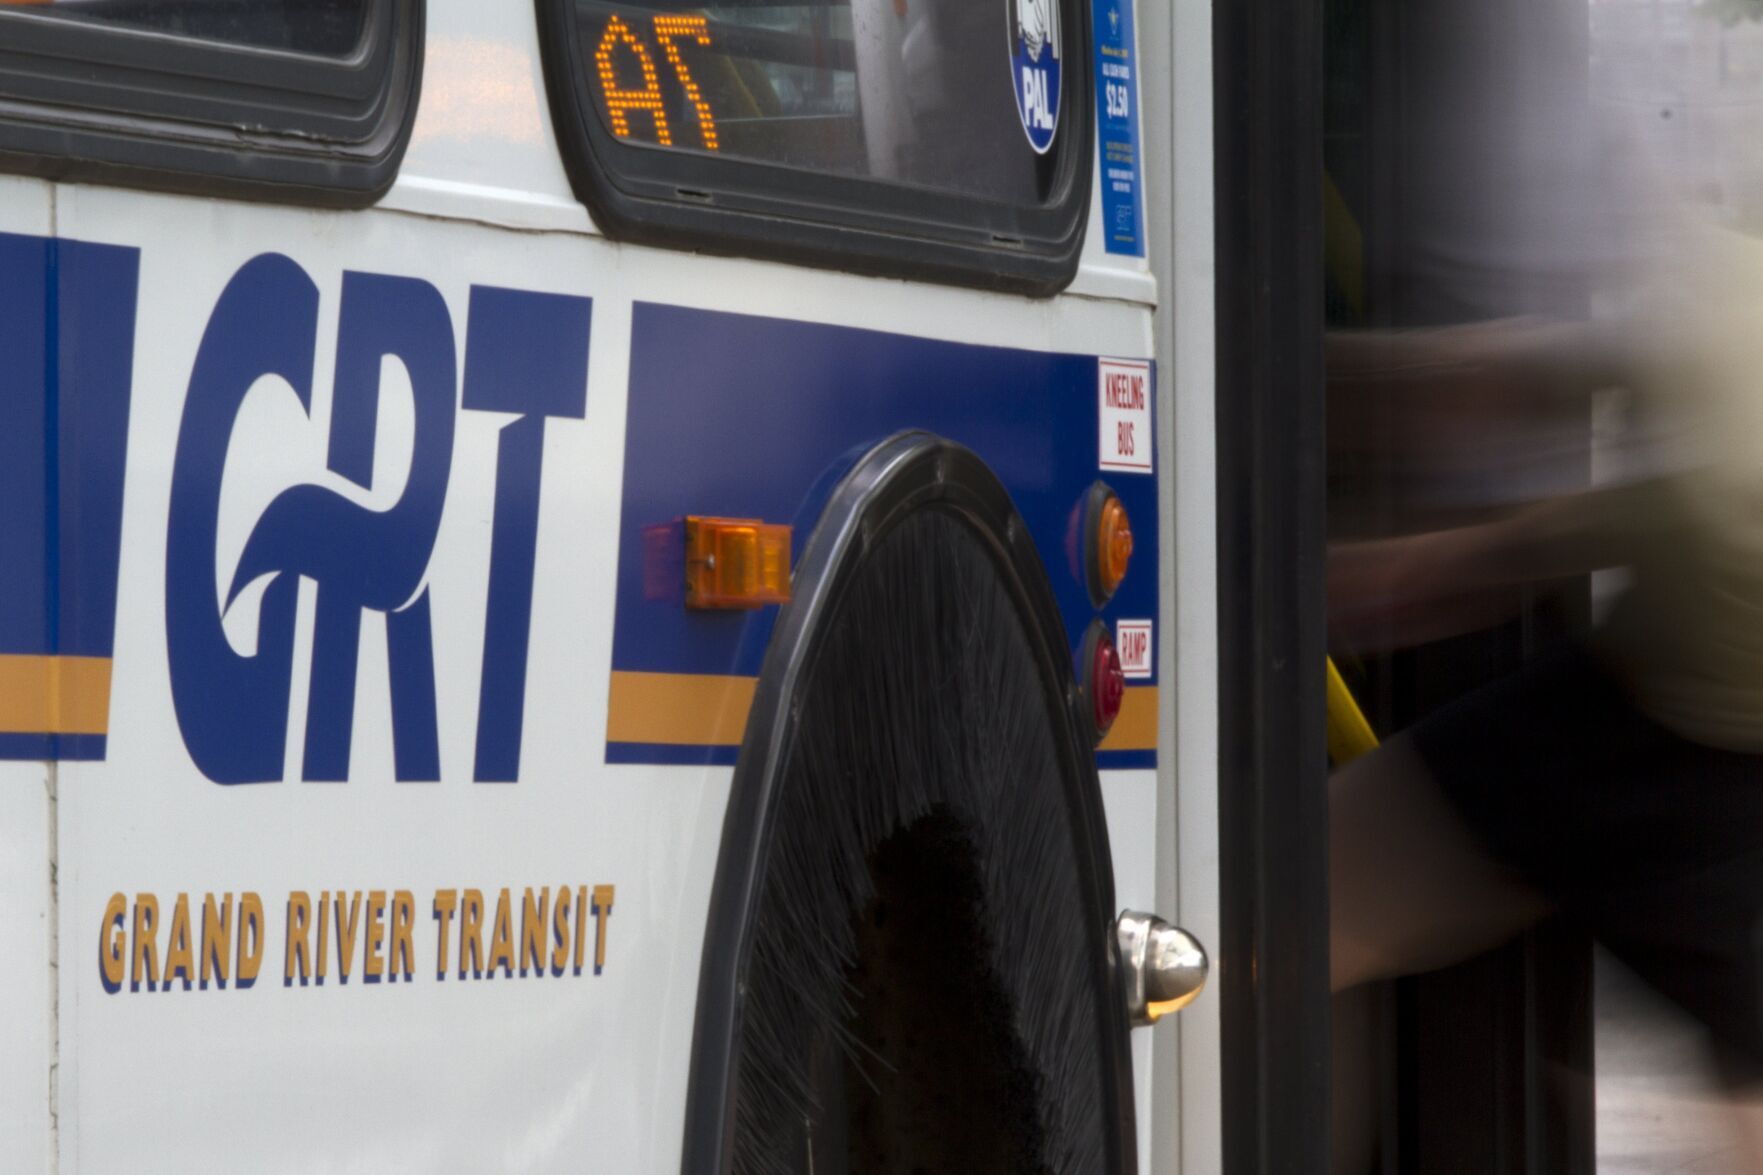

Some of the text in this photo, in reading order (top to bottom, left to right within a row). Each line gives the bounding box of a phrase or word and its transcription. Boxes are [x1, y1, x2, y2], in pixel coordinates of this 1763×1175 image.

[1022, 66, 1054, 130] PAL
[1106, 373, 1144, 410] KNEELING
[1117, 421, 1135, 456] BUS
[165, 252, 593, 785] GRT
[1121, 632, 1146, 666] RAMP
[99, 884, 615, 994] GRAND RIVER TRANSIT
